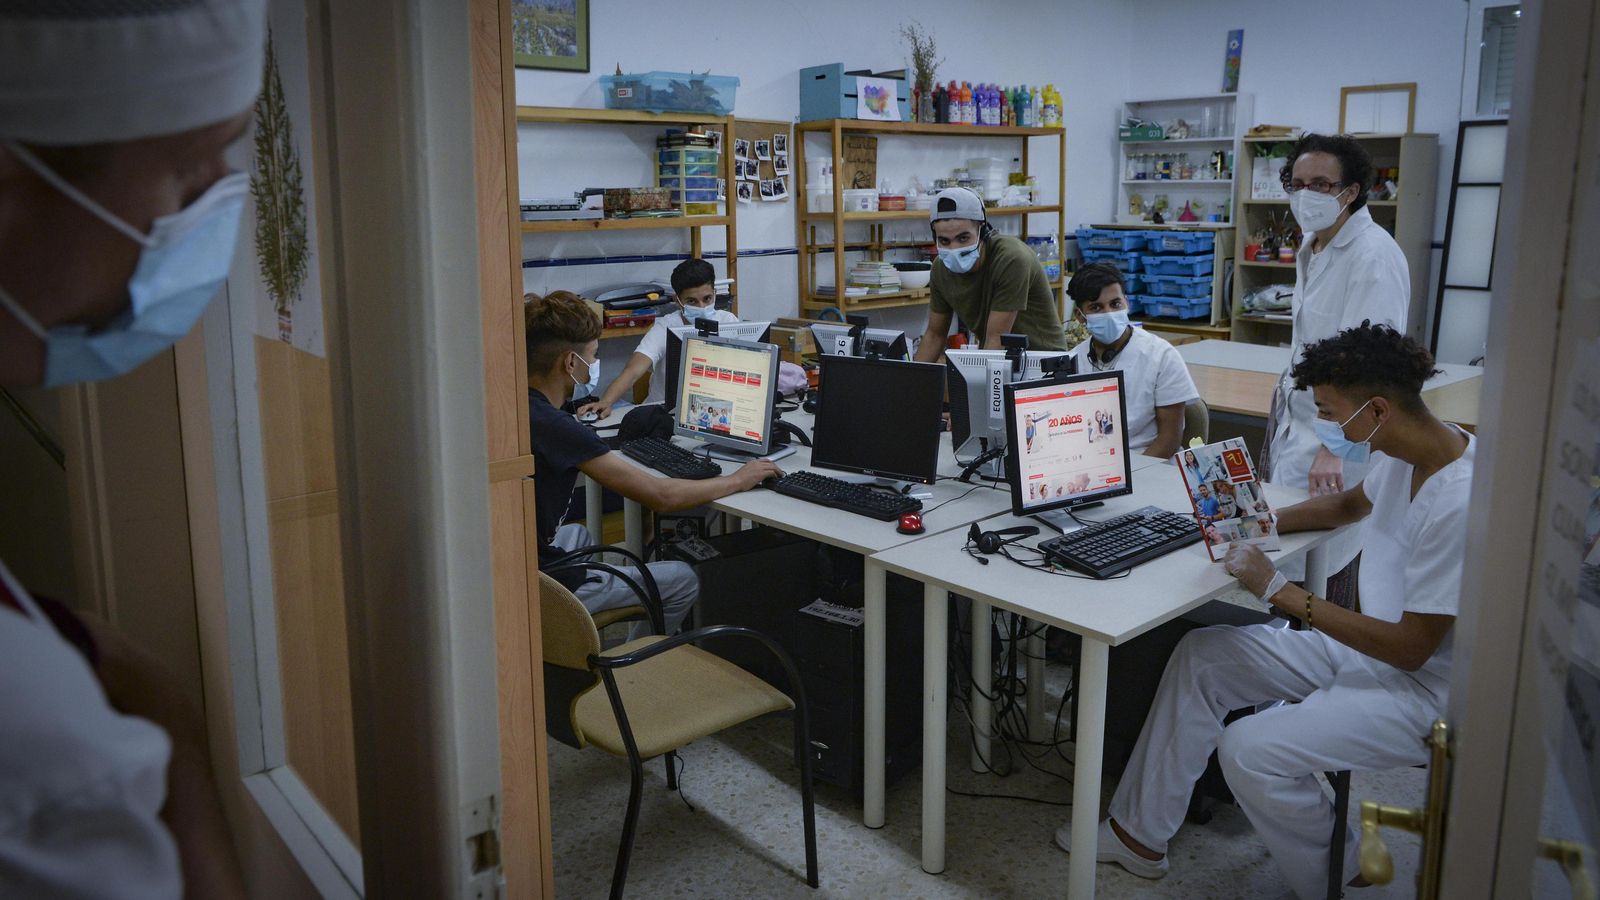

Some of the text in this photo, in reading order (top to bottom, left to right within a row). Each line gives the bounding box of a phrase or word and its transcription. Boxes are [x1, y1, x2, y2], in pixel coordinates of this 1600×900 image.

[838, 339, 846, 347] 6
[993, 379, 1001, 412] EQUIPO
[1048, 414, 1083, 428] 20 AÑOS
